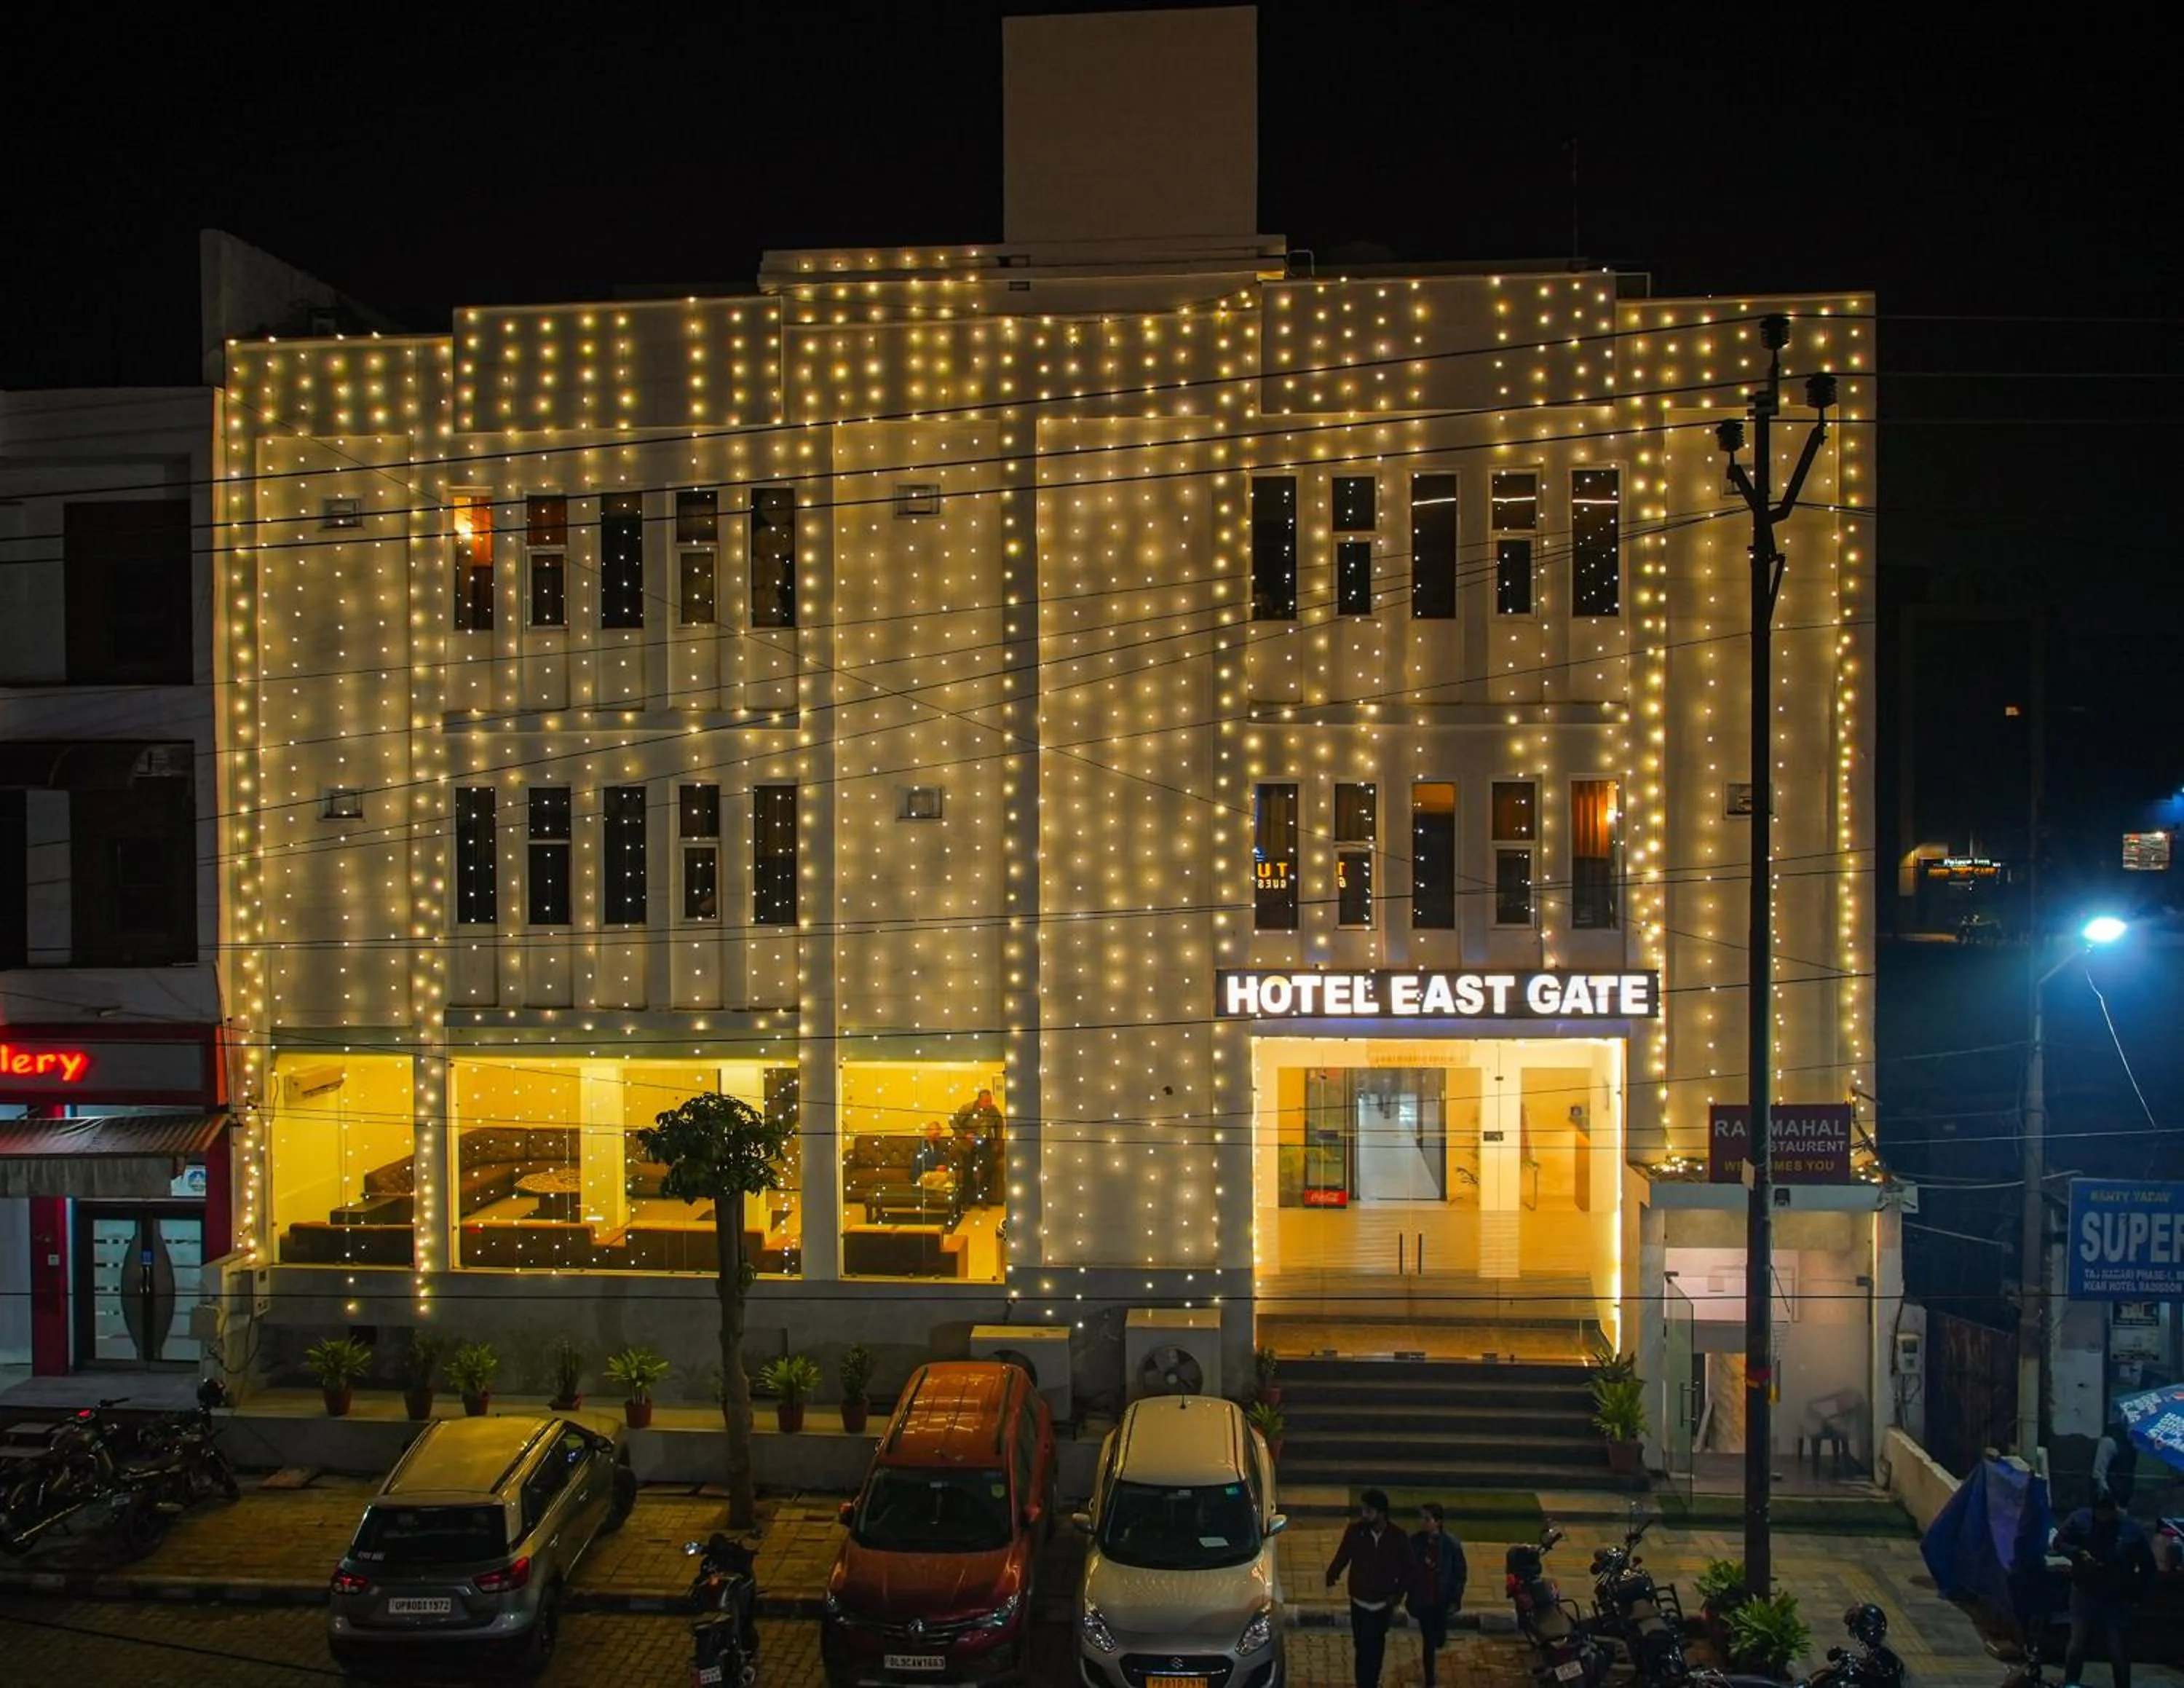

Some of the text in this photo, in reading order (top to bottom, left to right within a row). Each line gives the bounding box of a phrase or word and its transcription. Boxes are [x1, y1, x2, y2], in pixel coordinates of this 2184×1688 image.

[1227, 974, 1649, 1014] HOTEL EAST GATE
[1, 1044, 82, 1081] lery
[1714, 1119, 1749, 1137] RA
[1768, 1141, 1845, 1152] STAURENT
[1725, 1159, 1835, 1172] WEMES YOU
